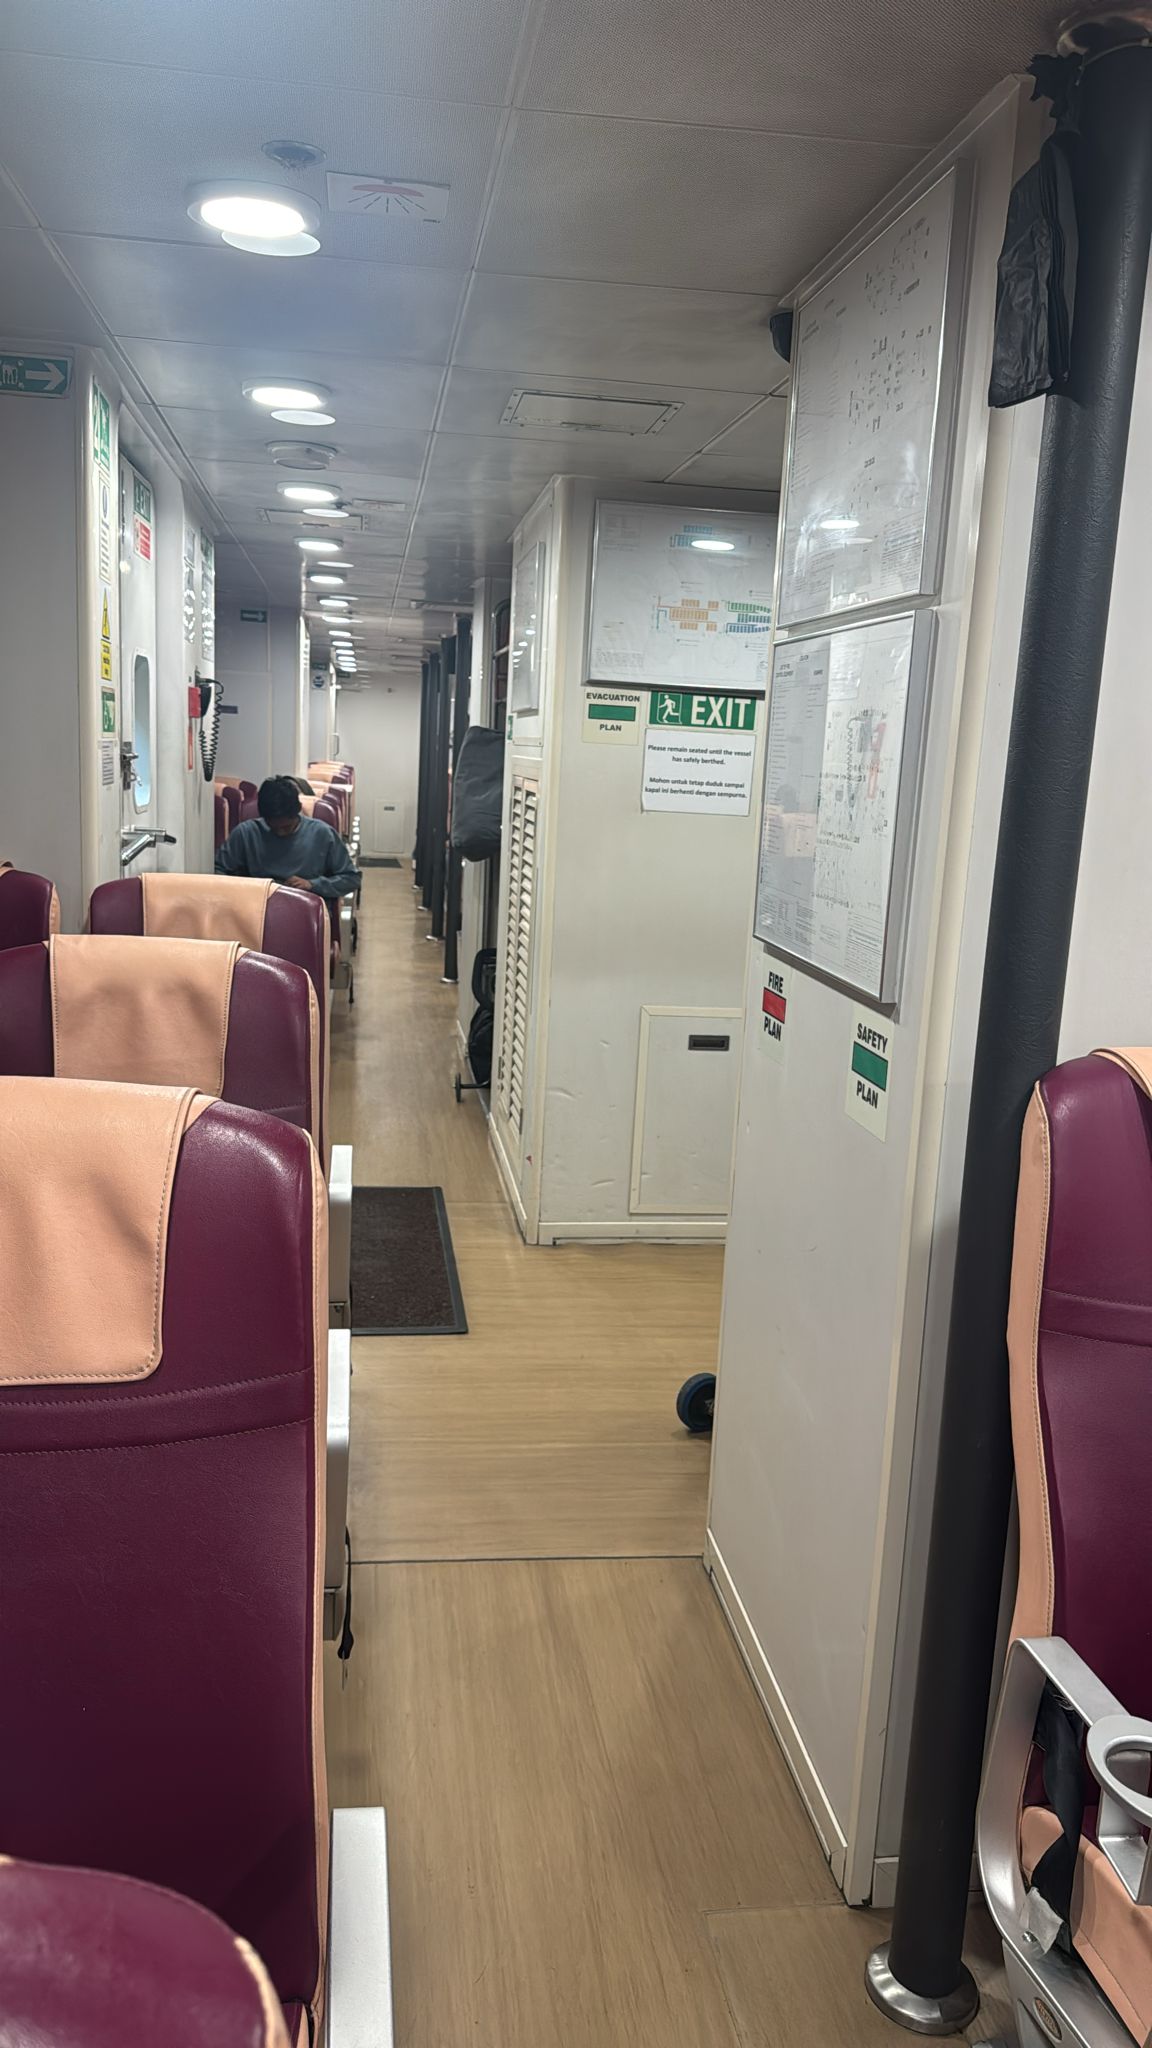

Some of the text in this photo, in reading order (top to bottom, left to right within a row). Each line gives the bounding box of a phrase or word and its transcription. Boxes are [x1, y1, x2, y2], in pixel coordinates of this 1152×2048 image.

[586, 692, 640, 702] EVACUATION
[691, 696, 752, 727] EXIT
[600, 724, 622, 732] PLAN
[768, 972, 783, 994] FIRE
[764, 1016, 781, 1042] PLAN
[857, 1023, 888, 1053] SAFETY
[856, 1080, 878, 1109] PLAN
